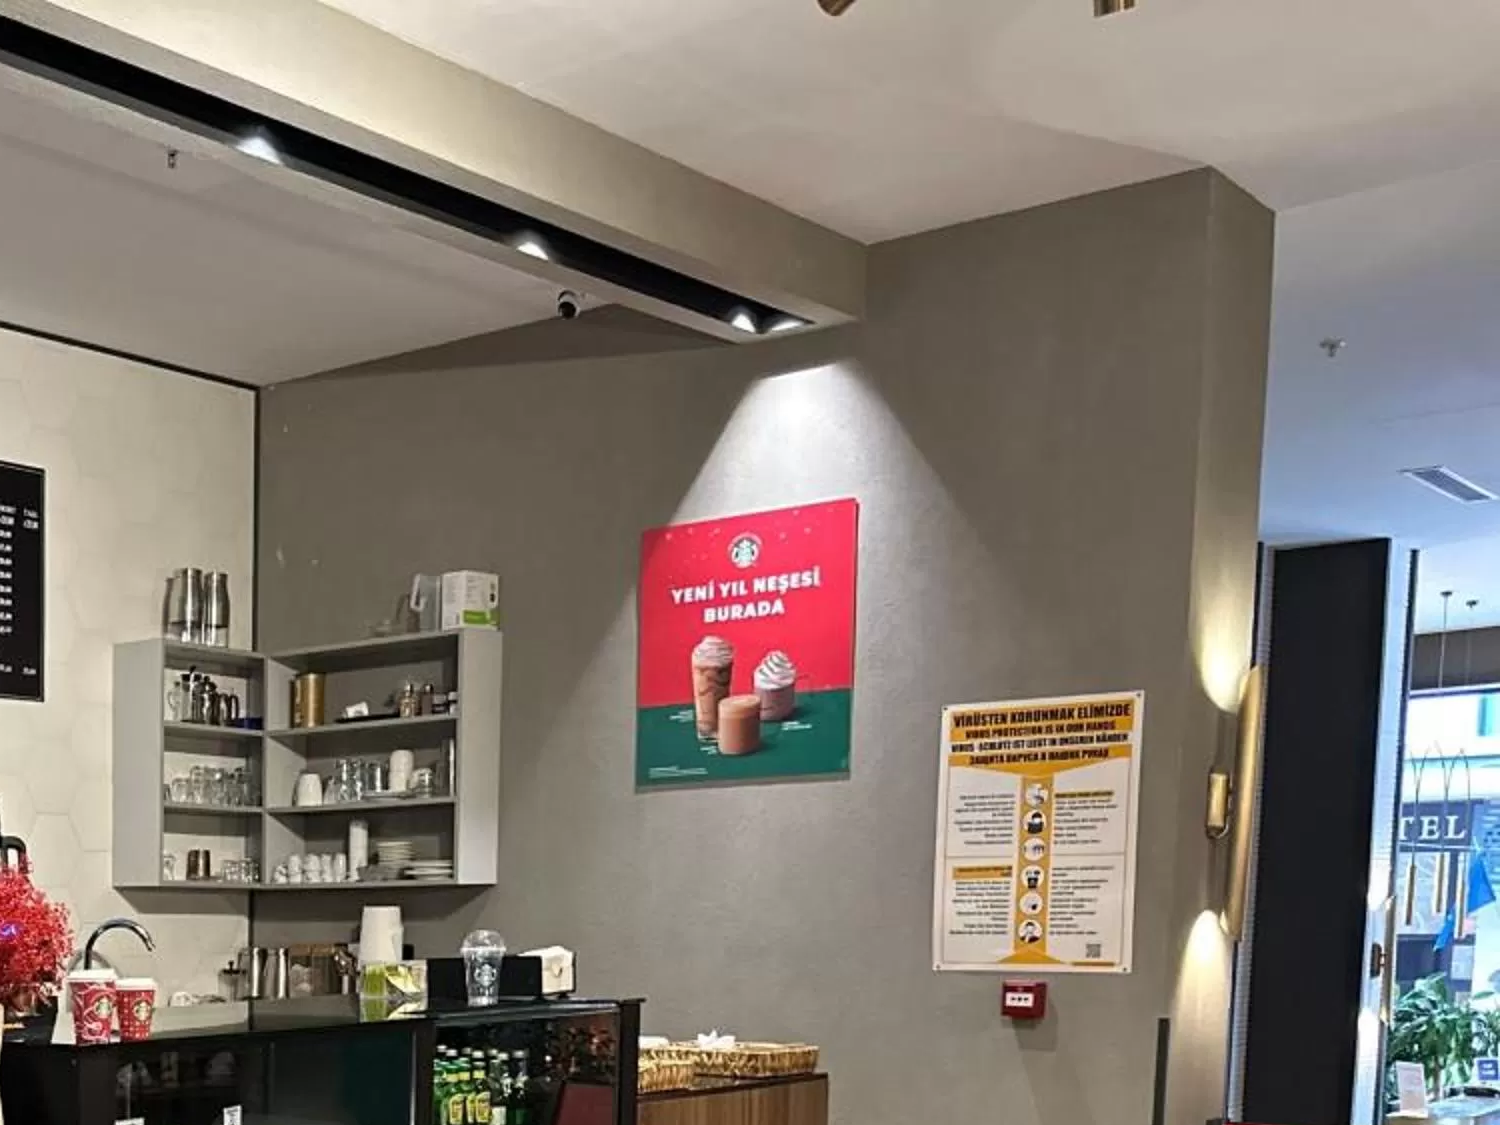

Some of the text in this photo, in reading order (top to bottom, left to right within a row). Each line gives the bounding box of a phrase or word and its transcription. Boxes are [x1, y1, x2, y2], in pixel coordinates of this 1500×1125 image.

[671, 565, 820, 604] YENİ YIL NEŞESİ
[703, 598, 785, 623] BURADA
[953, 703, 1130, 728] VİRÜSTEN KORUNMAK ELİMİZDE
